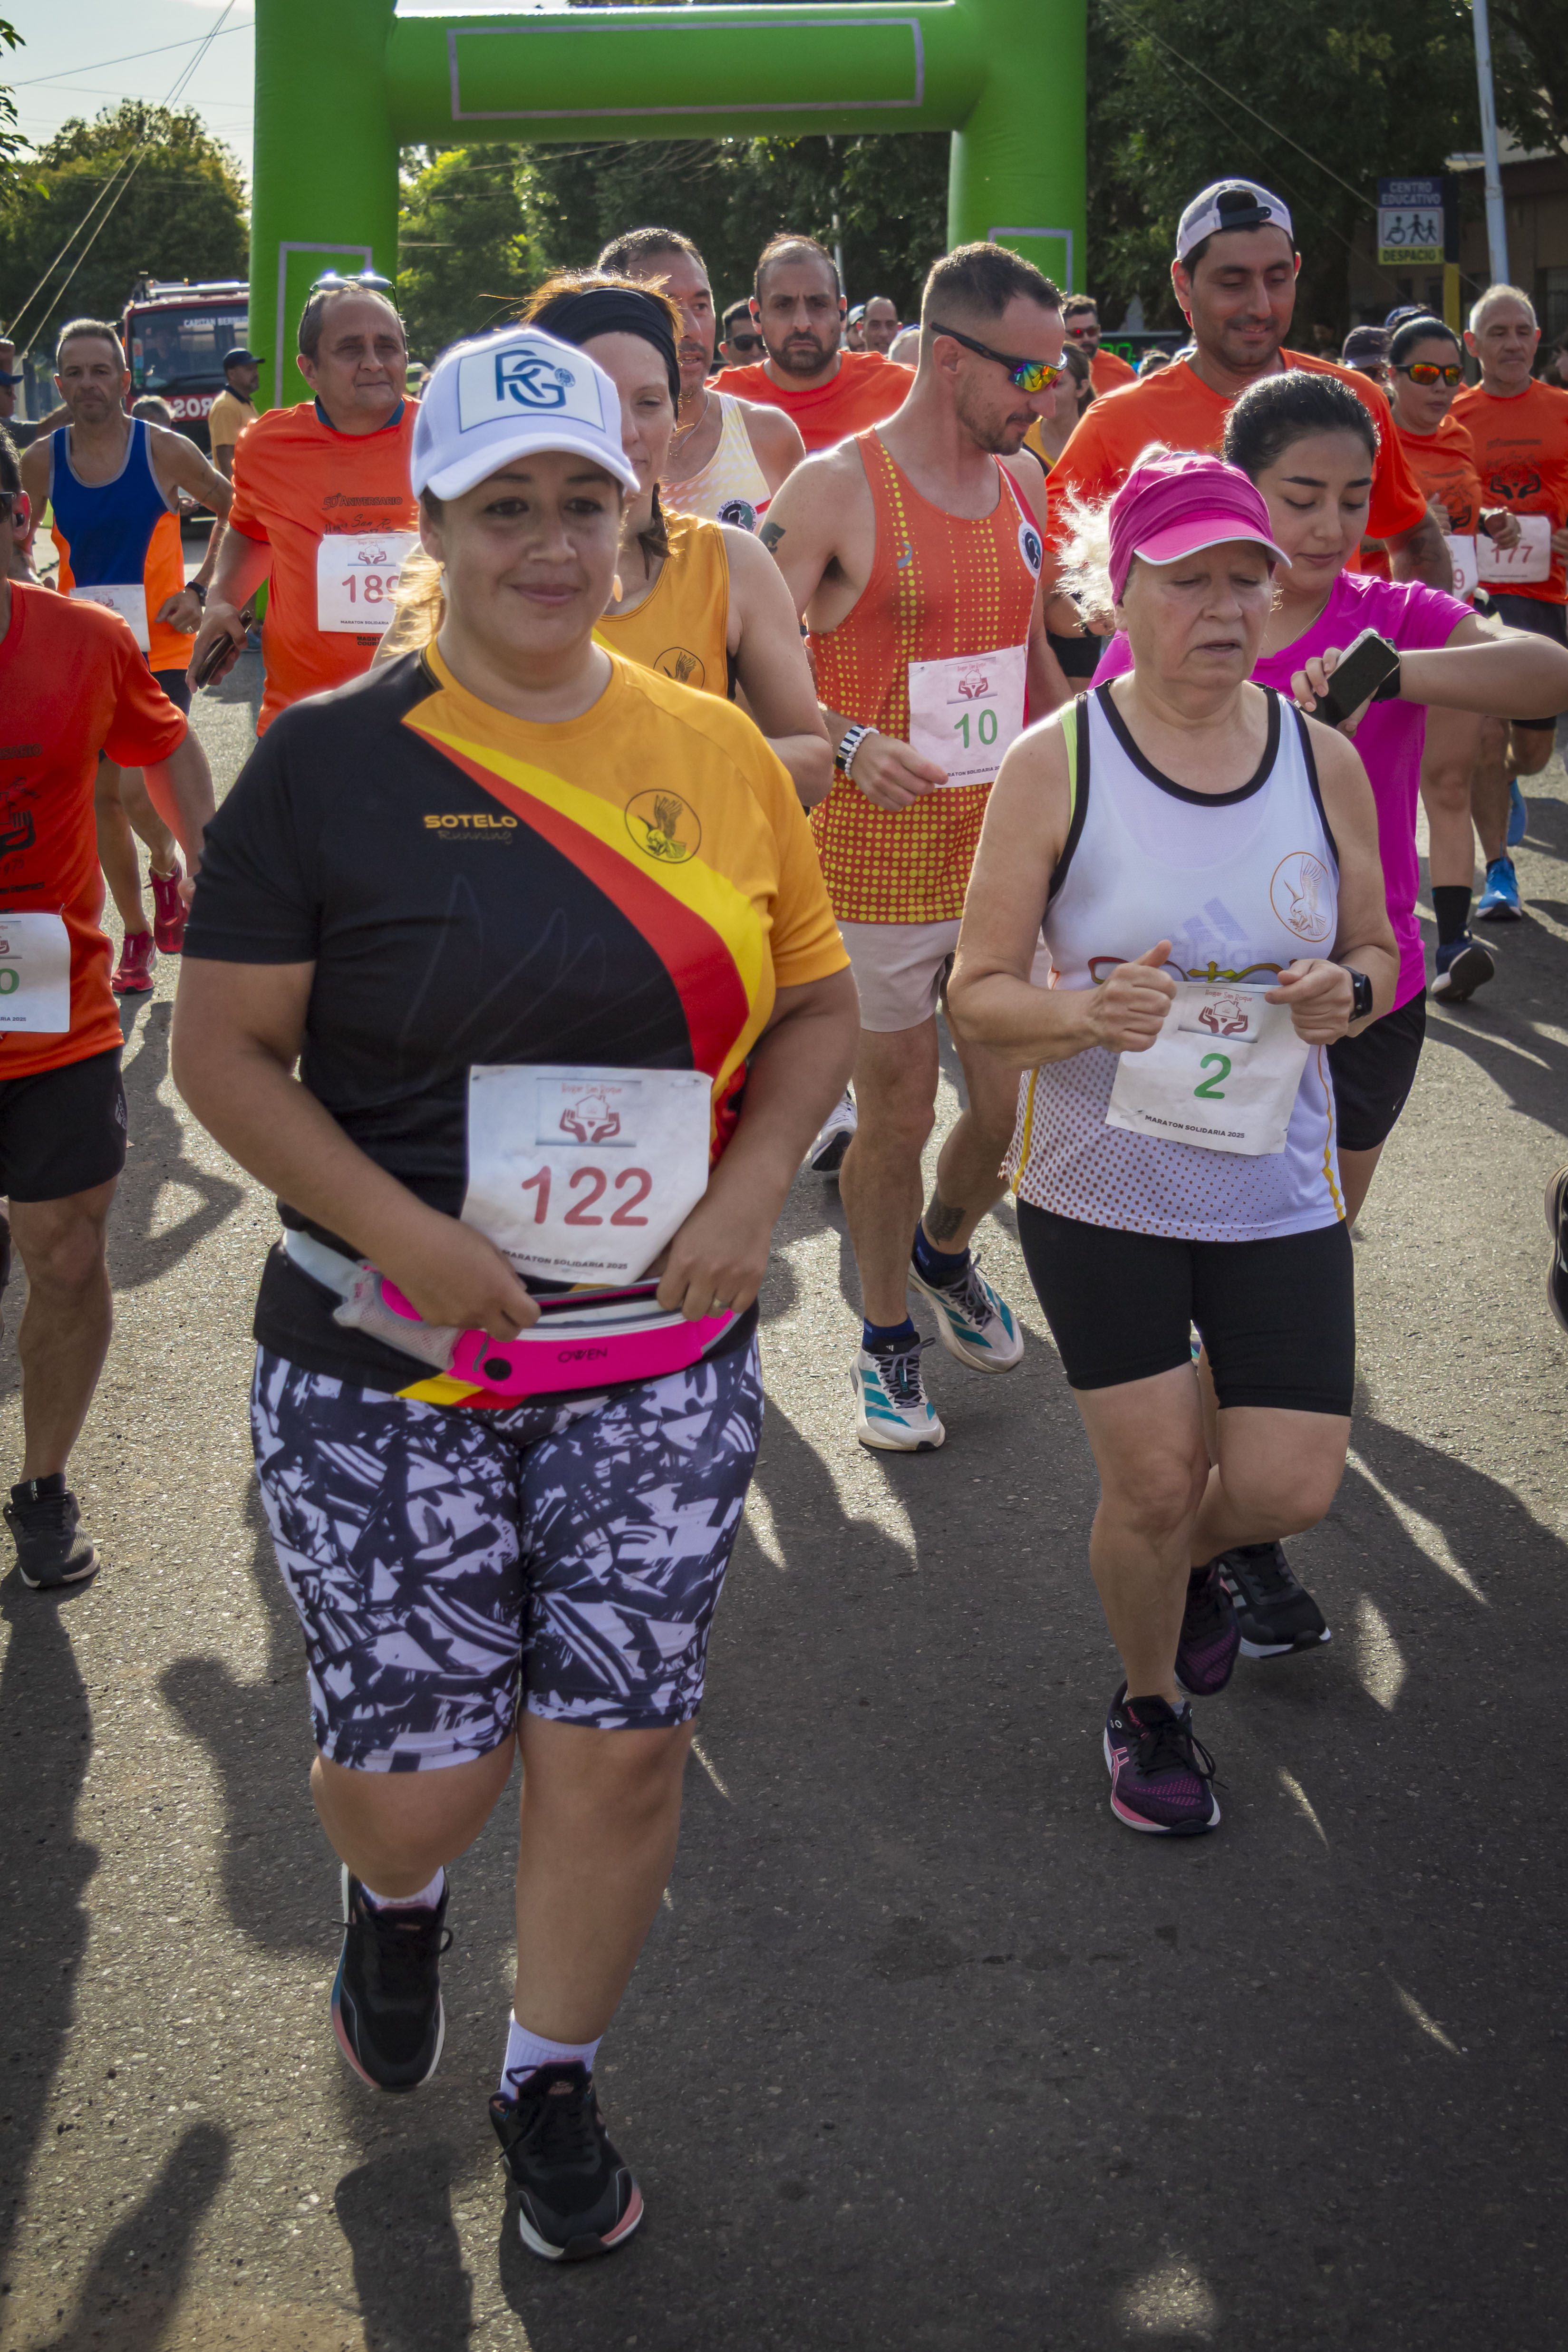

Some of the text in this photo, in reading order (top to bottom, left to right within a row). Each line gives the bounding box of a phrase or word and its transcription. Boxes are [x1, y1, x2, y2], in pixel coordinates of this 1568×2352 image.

[1389, 182, 1432, 193] CENTRO
[1381, 194, 1441, 205] EDUCATIVO
[1383, 250, 1436, 261] DESPACIO
[1491, 546, 1533, 563] 177
[954, 709, 997, 749] 10
[424, 814, 518, 828] SOTELO
[1194, 1053, 1231, 1099] 2
[1145, 1115, 1184, 1129] MARATON
[1185, 1125, 1226, 1136] SOLIDARIA
[522, 1165, 652, 1226] 122
[502, 1249, 552, 1264] MARATON
[553, 1259, 604, 1268] SOLIDARIA
